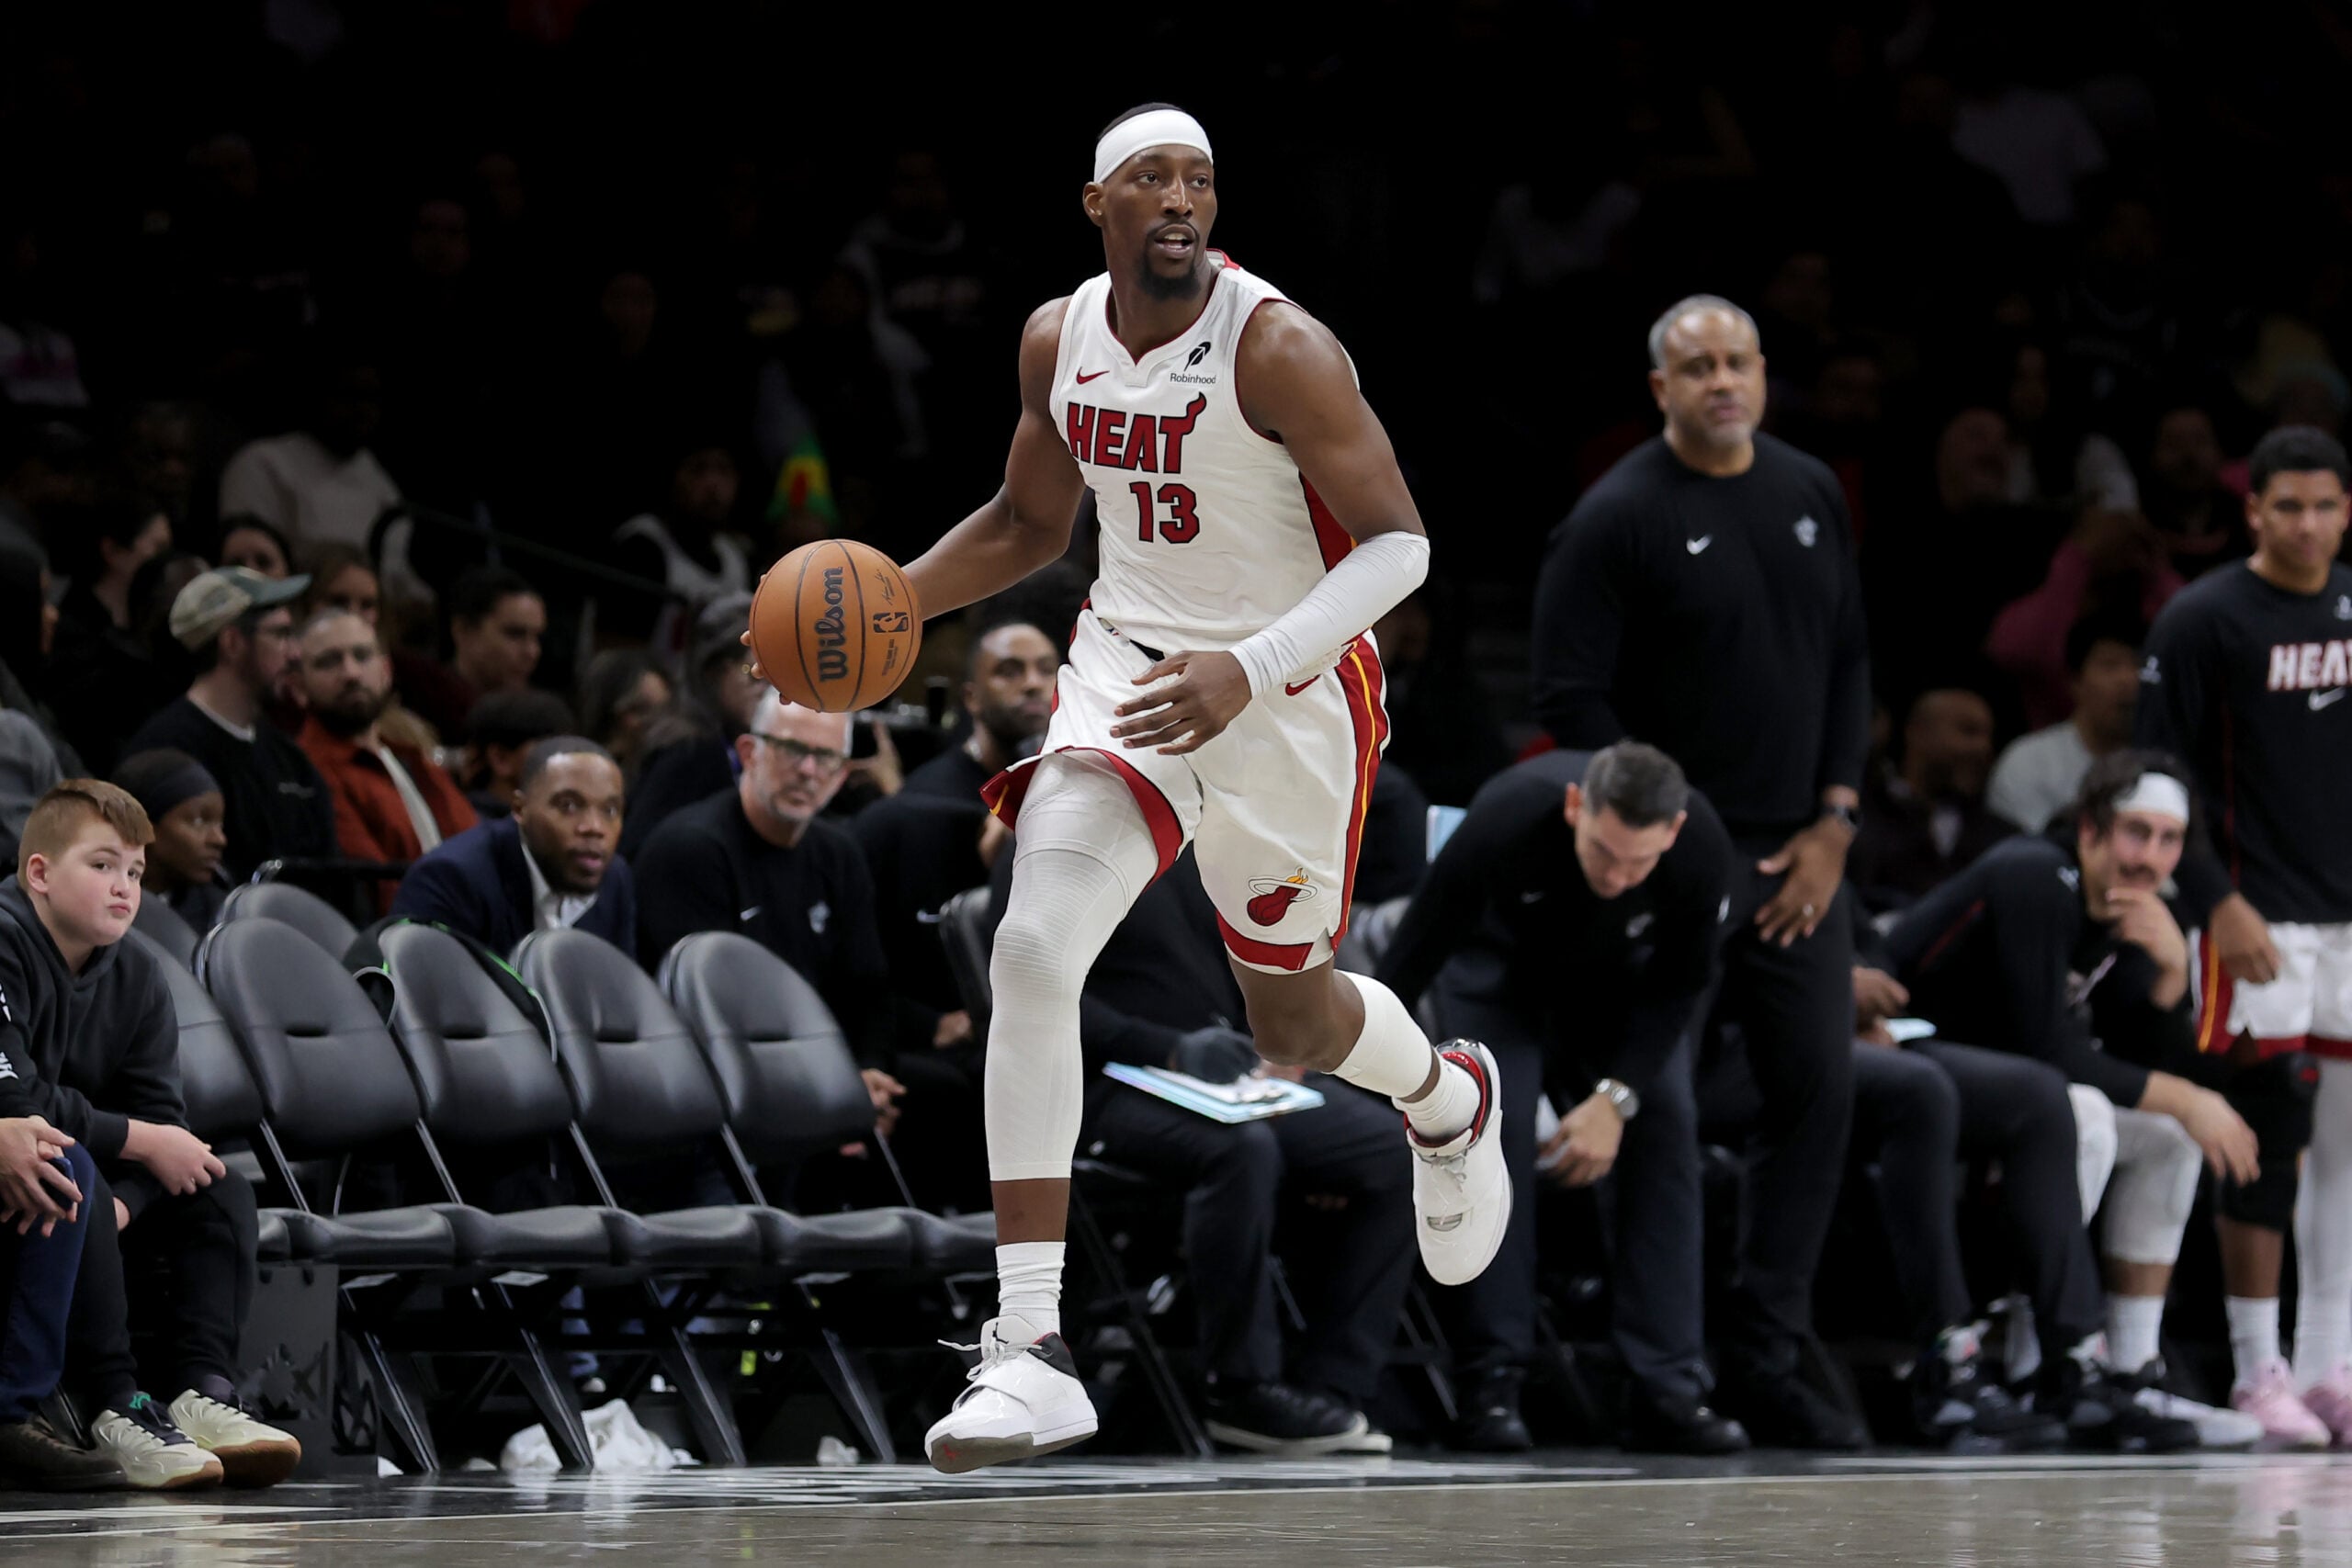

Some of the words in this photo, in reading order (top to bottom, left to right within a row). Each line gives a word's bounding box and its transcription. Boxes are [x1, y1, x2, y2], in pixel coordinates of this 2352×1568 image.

[1170, 373, 1216, 384] Robinhood
[1067, 391, 1207, 474] HEAT
[1129, 481, 1200, 544] 13
[814, 566, 849, 682] Wilson
